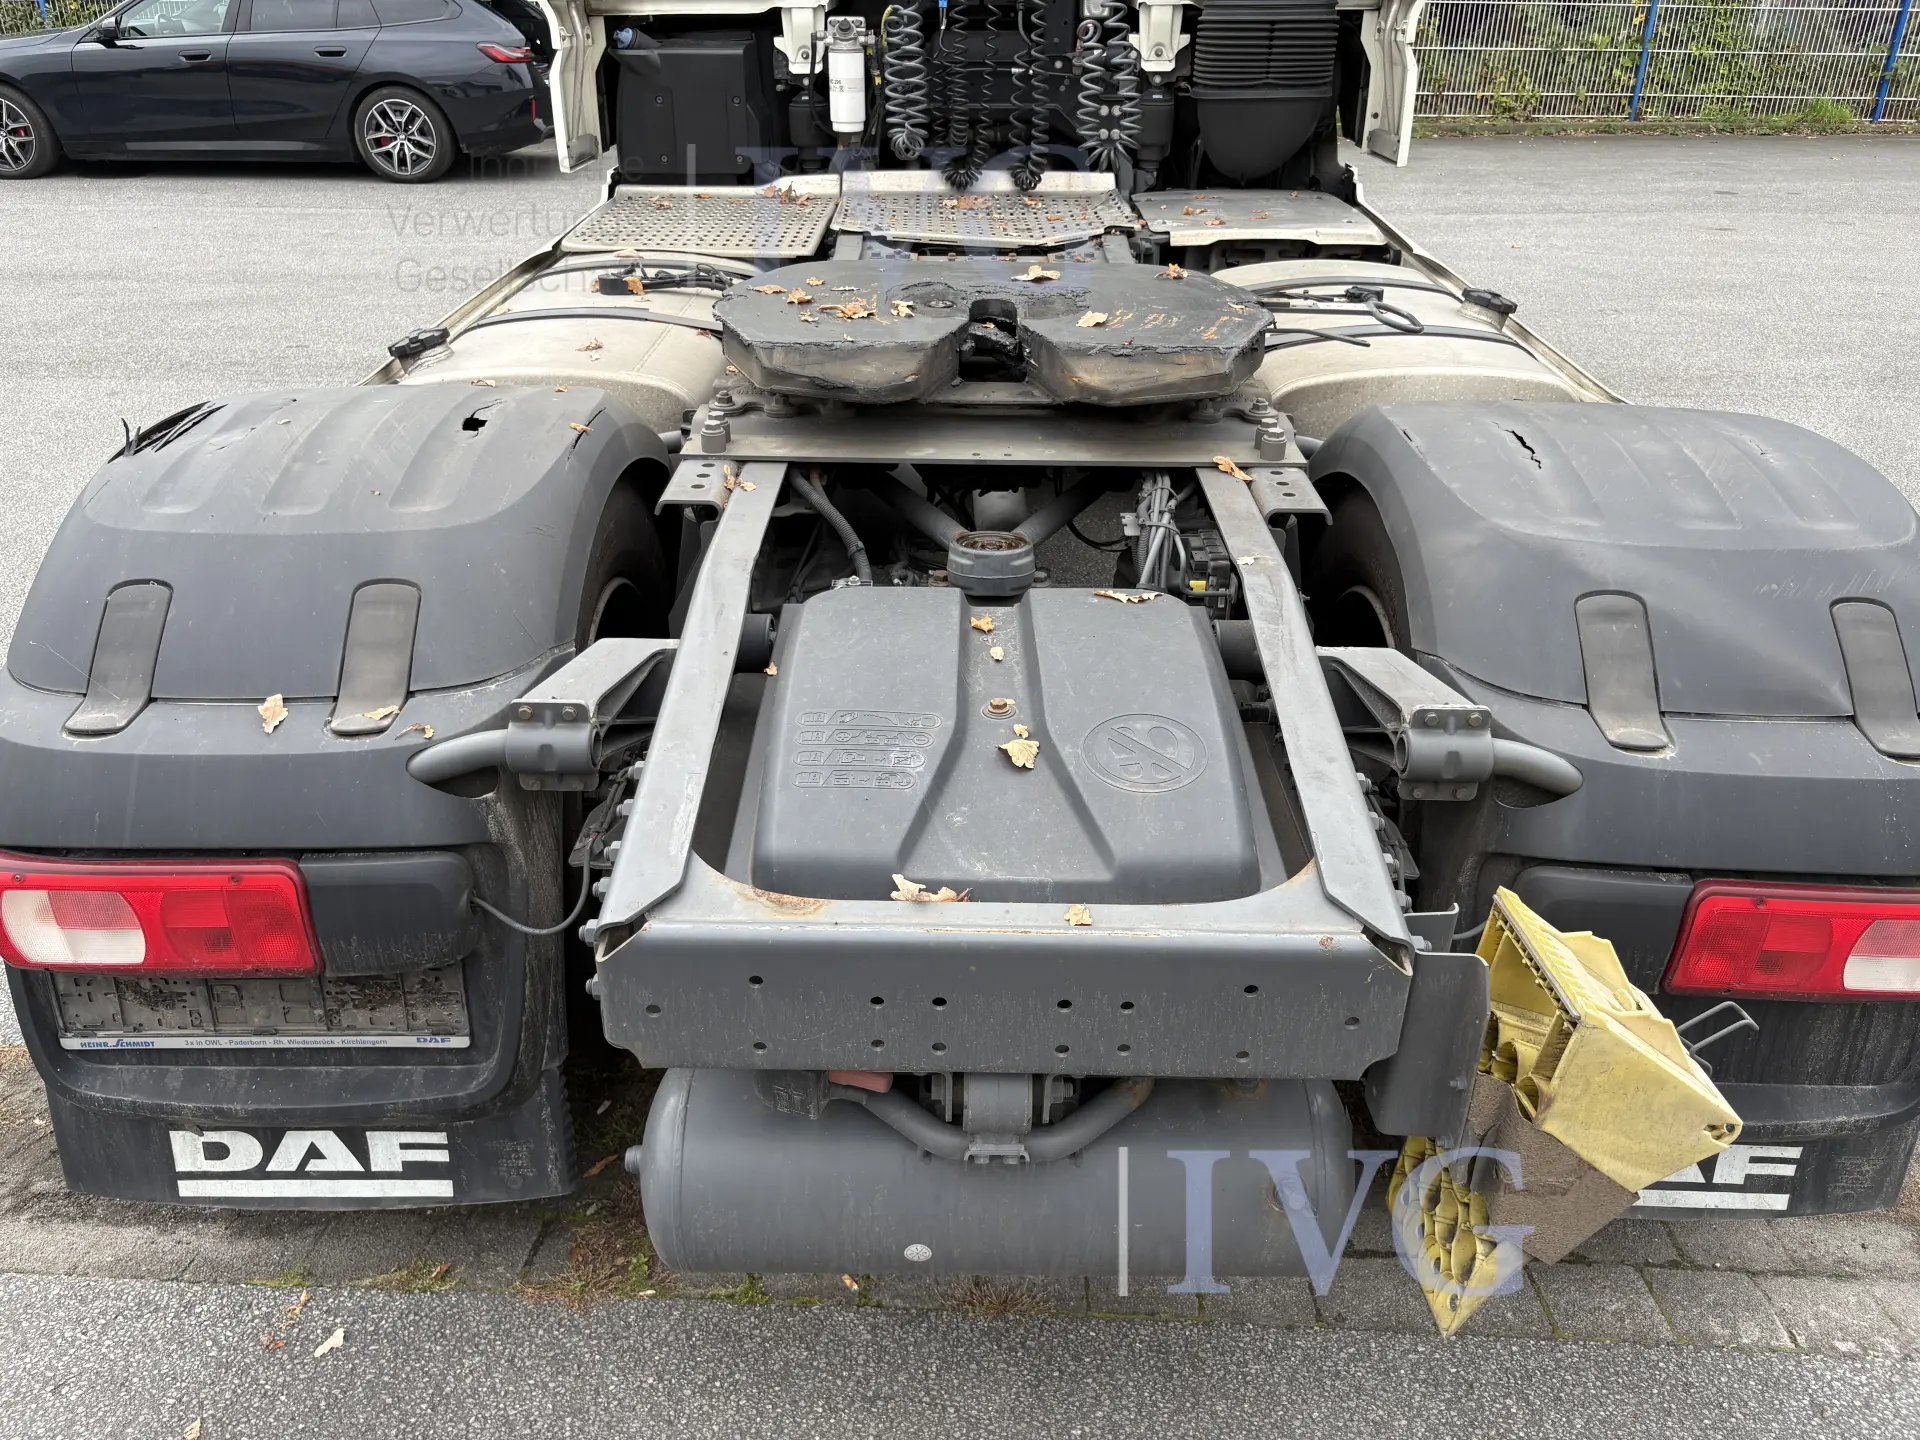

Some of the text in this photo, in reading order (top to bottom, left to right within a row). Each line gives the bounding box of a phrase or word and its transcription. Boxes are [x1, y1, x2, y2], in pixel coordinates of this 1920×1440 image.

[287, 1038, 335, 1046] Wiedenbrück
[341, 1038, 388, 1046] Kirchlengern
[168, 1130, 450, 1172] DAF
